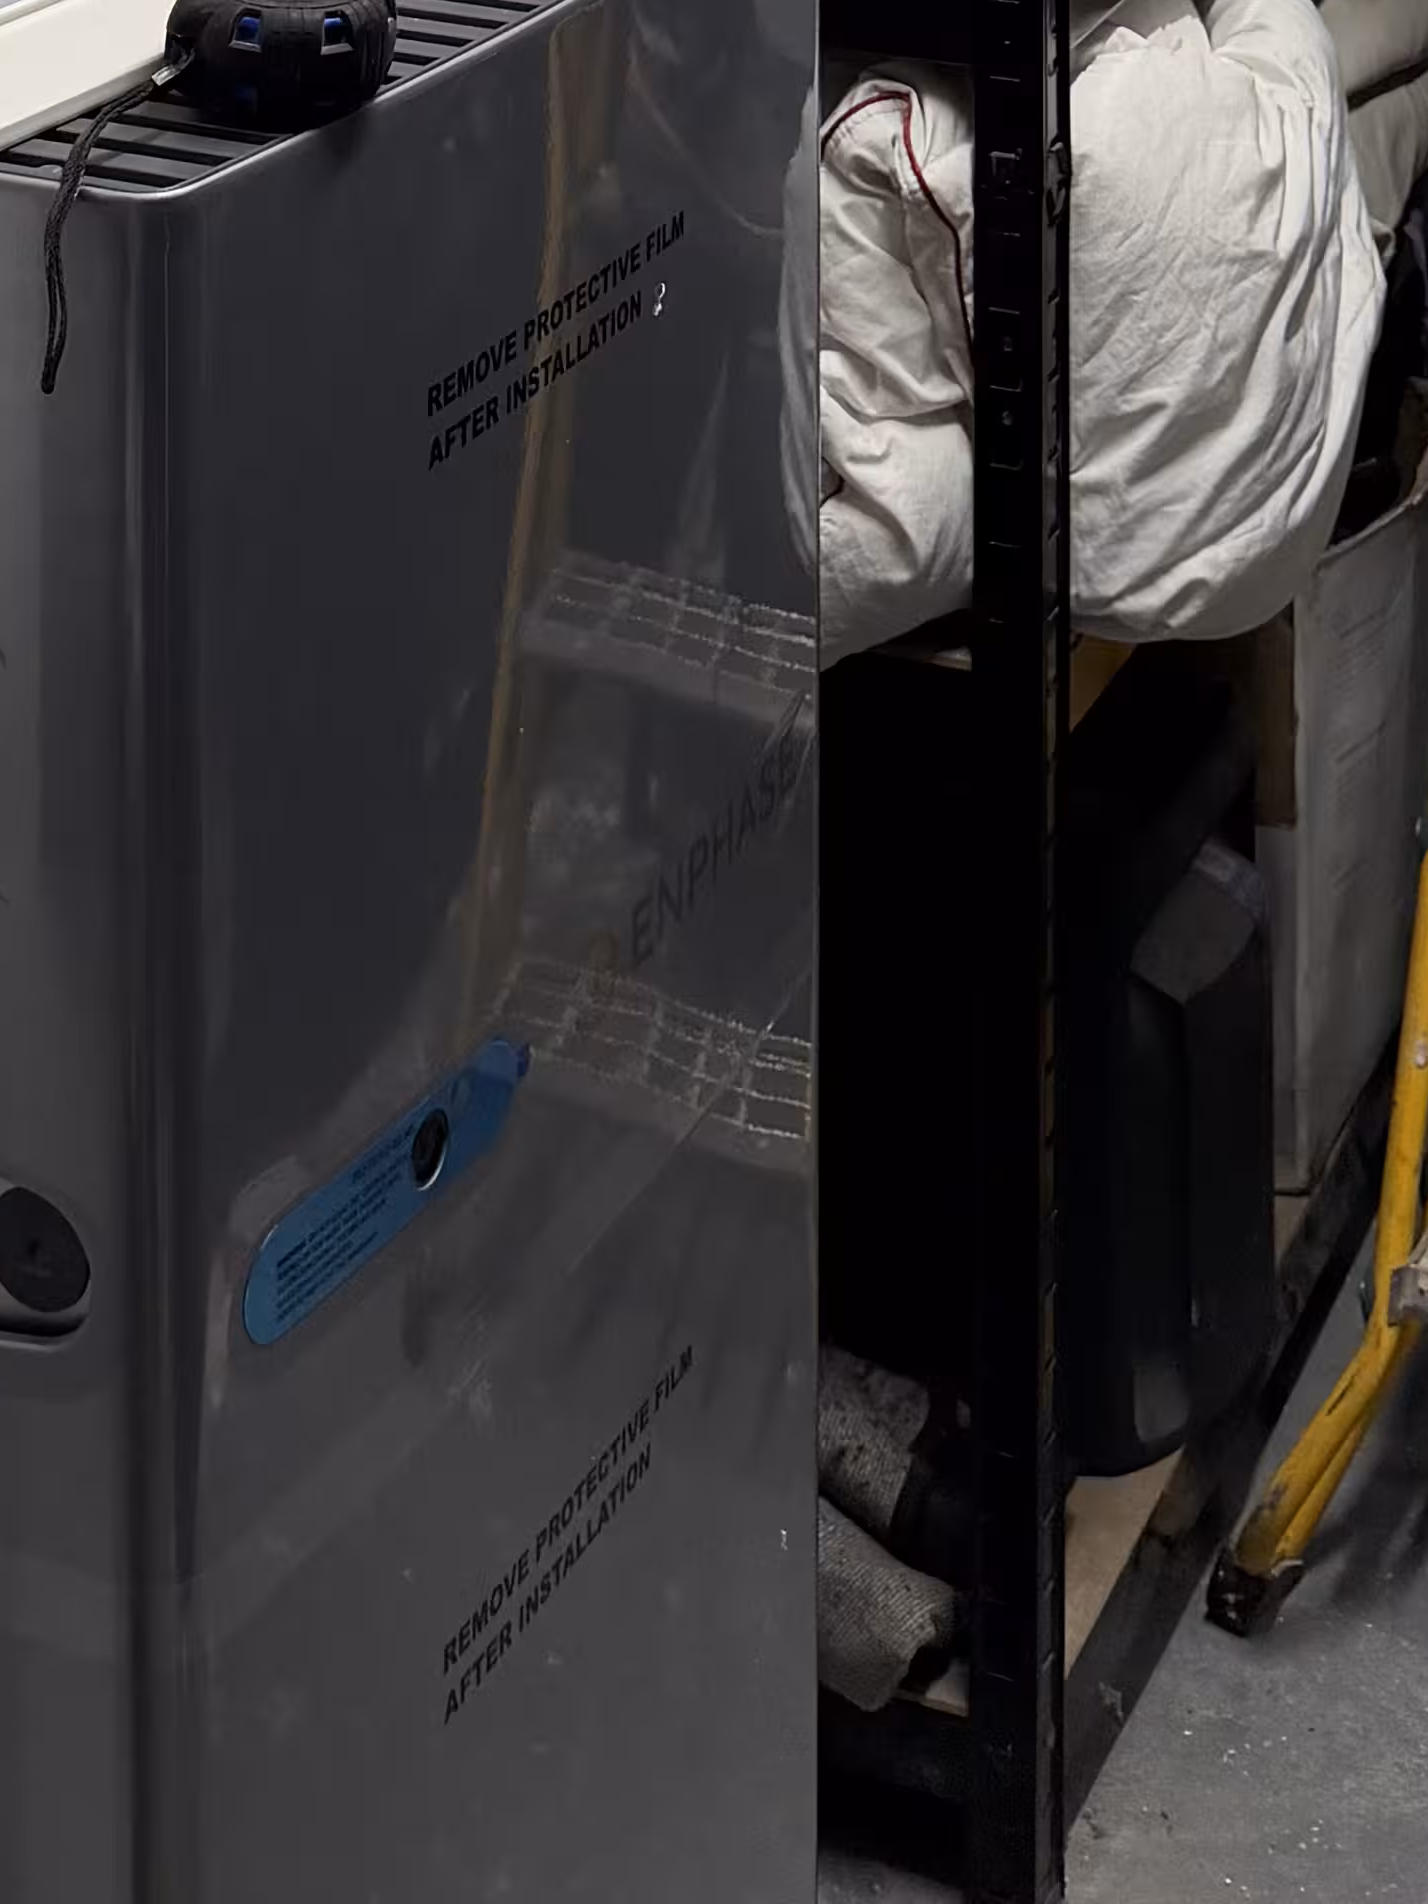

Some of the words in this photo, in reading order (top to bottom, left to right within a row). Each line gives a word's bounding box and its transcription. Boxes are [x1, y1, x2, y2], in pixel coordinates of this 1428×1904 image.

[427, 331, 517, 417] REMOVE
[523, 244, 642, 350] PROTECTIVE
[646, 211, 685, 263] FILM
[428, 396, 500, 471] AFTER
[506, 291, 643, 415] INSTALLATION
[443, 1548, 530, 1674] REMOVE
[535, 1403, 650, 1565] PROTECTIVE
[653, 1345, 694, 1413] FILM
[444, 1621, 513, 1725] AFTER
[518, 1442, 653, 1633] INSTALLATION
